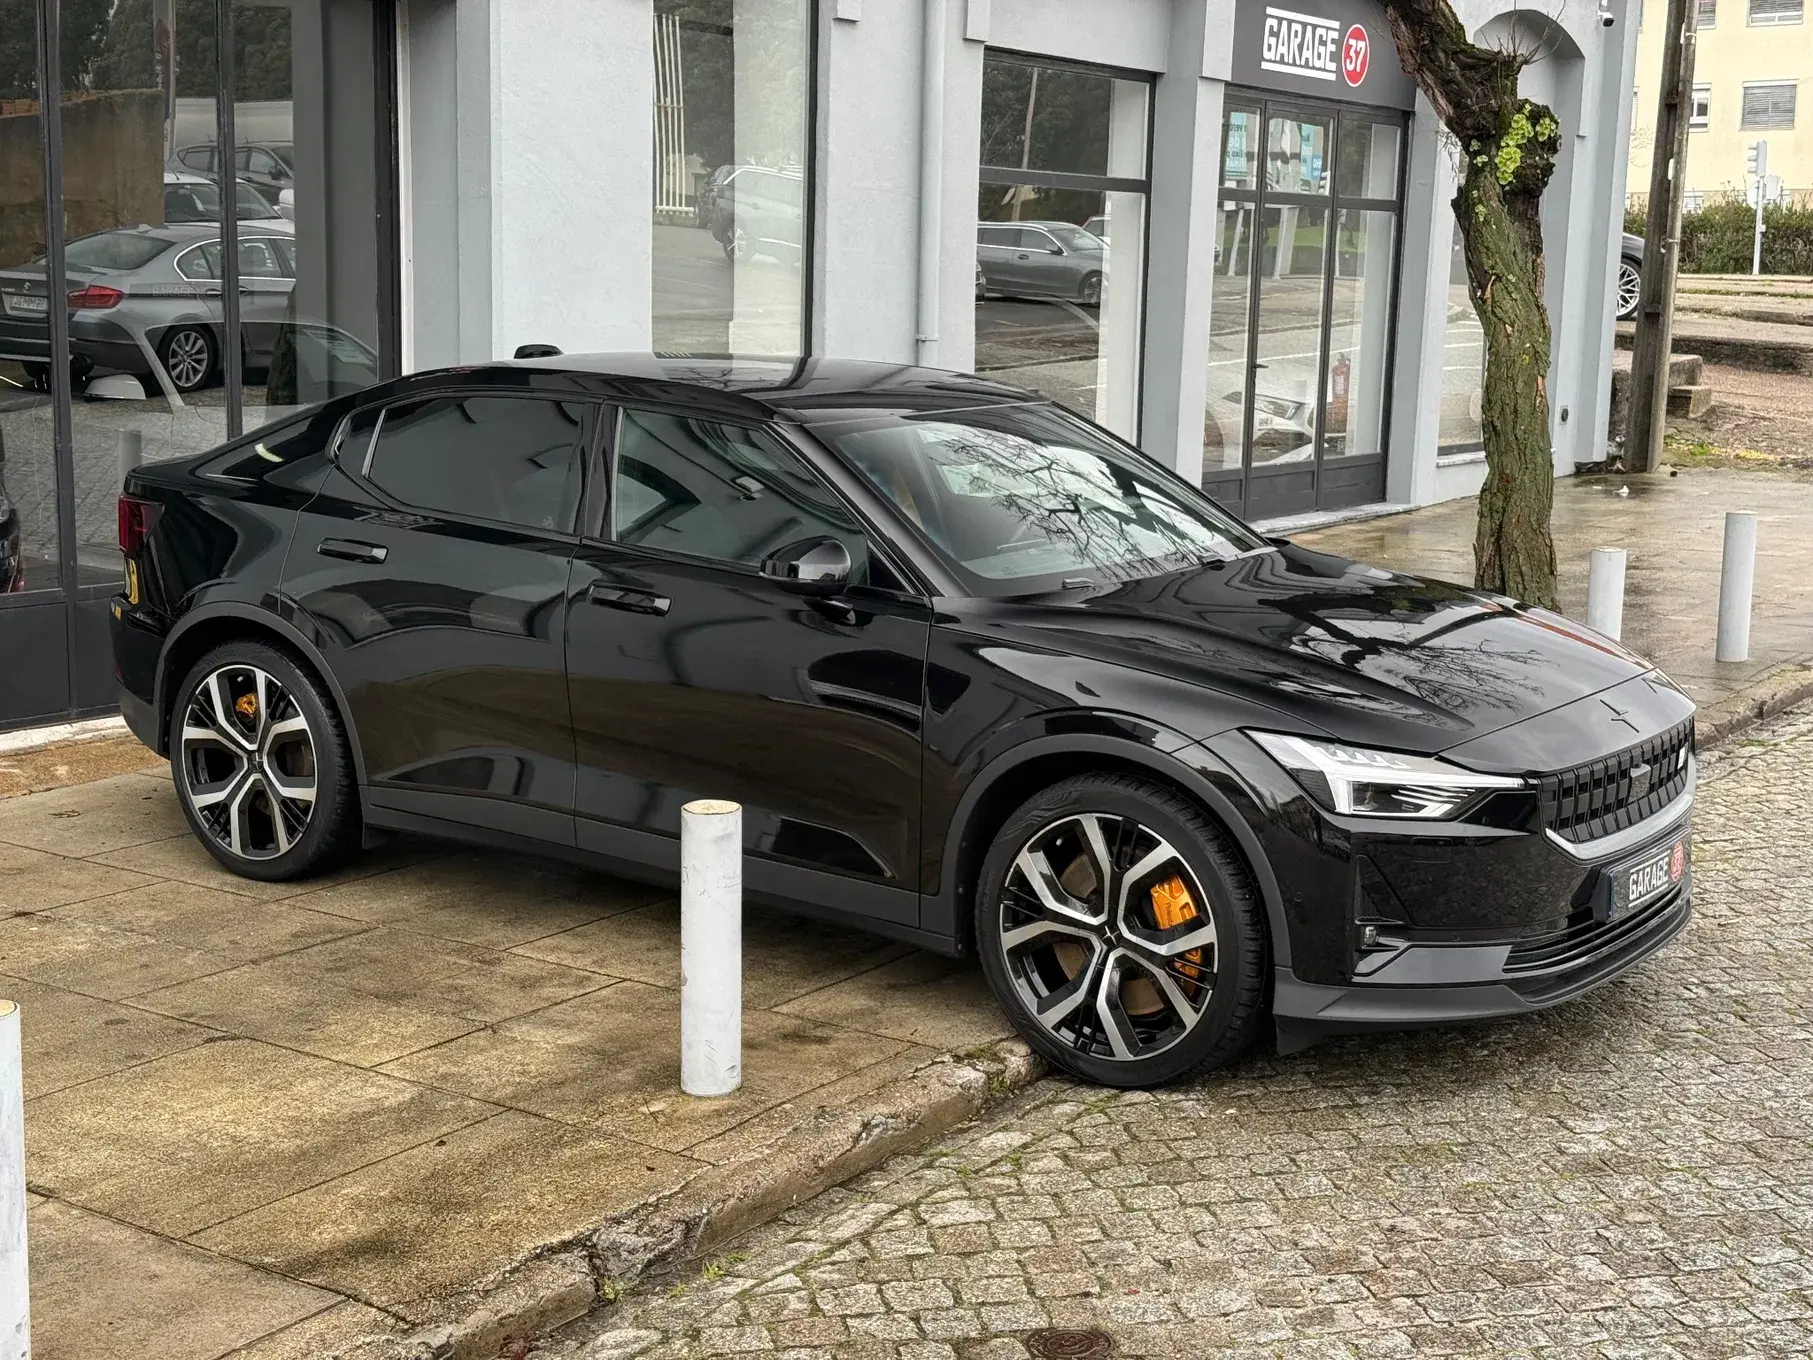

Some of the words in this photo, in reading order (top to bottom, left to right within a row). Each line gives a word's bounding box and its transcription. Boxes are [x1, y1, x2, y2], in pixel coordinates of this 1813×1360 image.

[1262, 17, 1339, 72] GARAGE
[1346, 38, 1366, 73] 37
[153, 286, 193, 297] GARAGE
[1629, 857, 1669, 901] GARAGE
